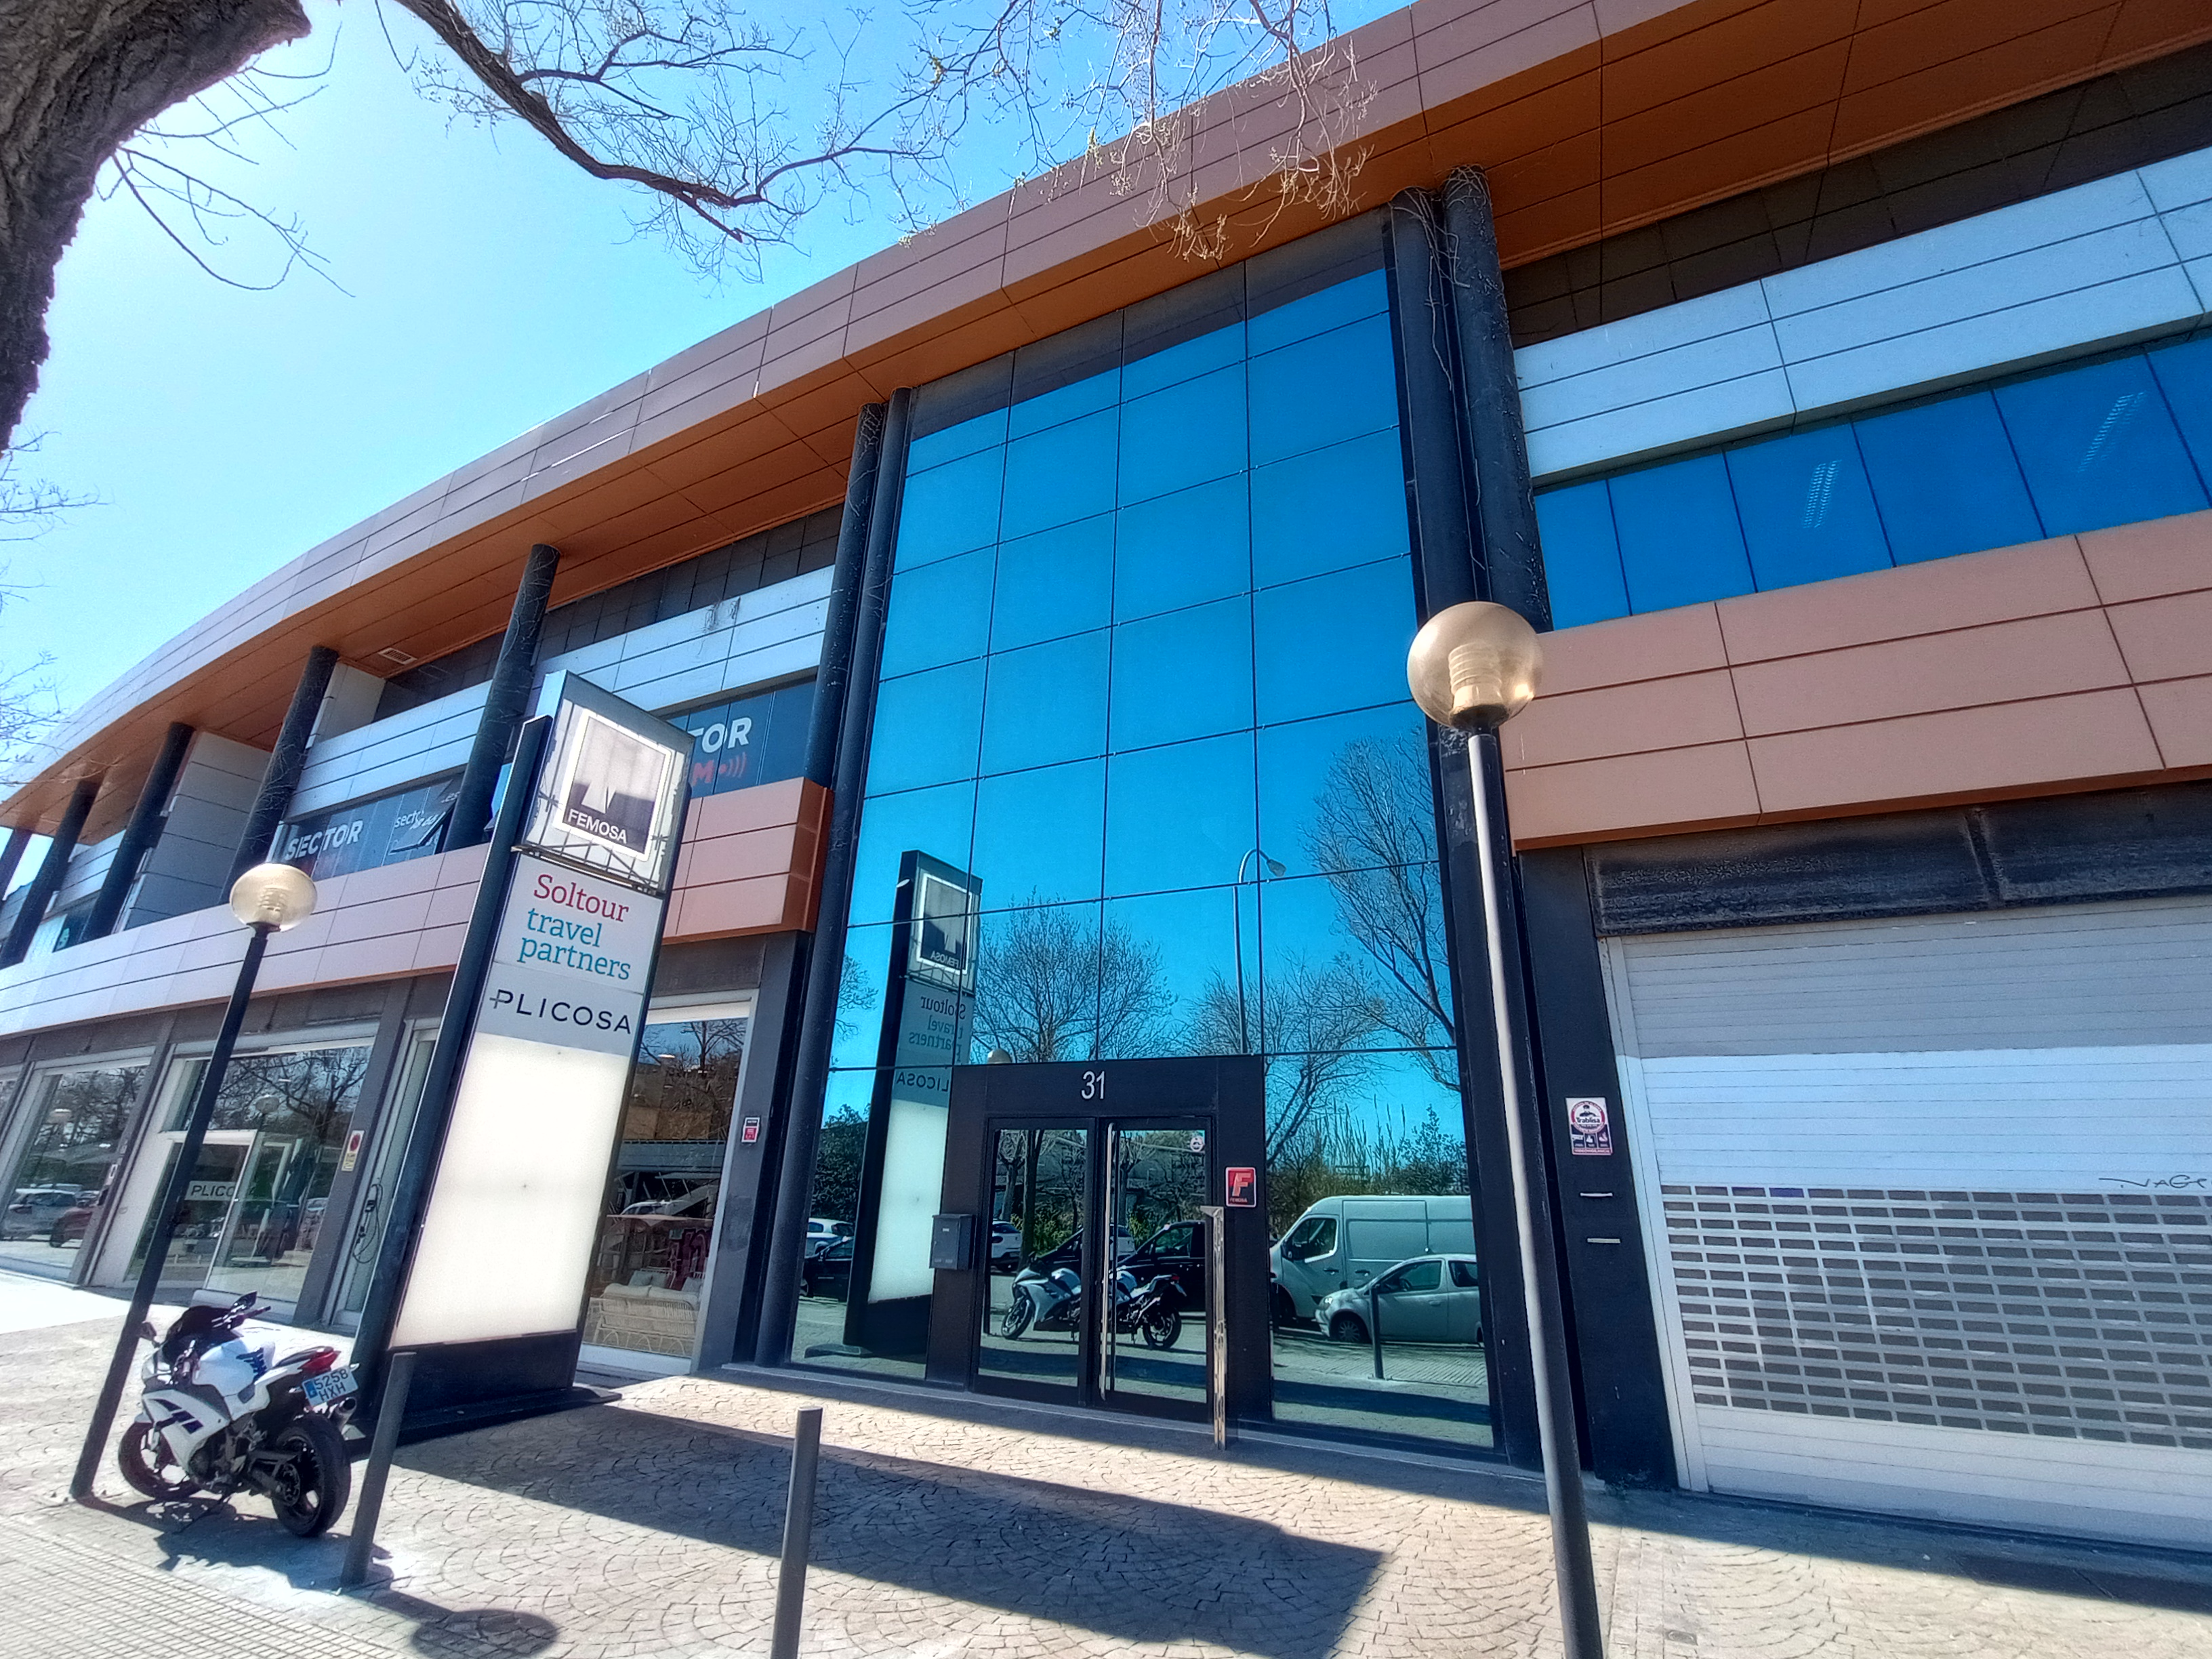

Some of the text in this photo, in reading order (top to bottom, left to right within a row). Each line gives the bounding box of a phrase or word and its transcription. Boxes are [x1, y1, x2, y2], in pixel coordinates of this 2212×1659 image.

[285, 820, 364, 861] SECTOR
[568, 808, 628, 844] FEMOSA
[534, 874, 629, 922] Soltour
[527, 907, 602, 947] travel
[517, 936, 631, 981] partners
[490, 989, 632, 1035] PLICOSA
[1081, 1071, 1106, 1100] 31
[313, 1369, 348, 1389] 5258
[319, 1382, 346, 1401] HXH
